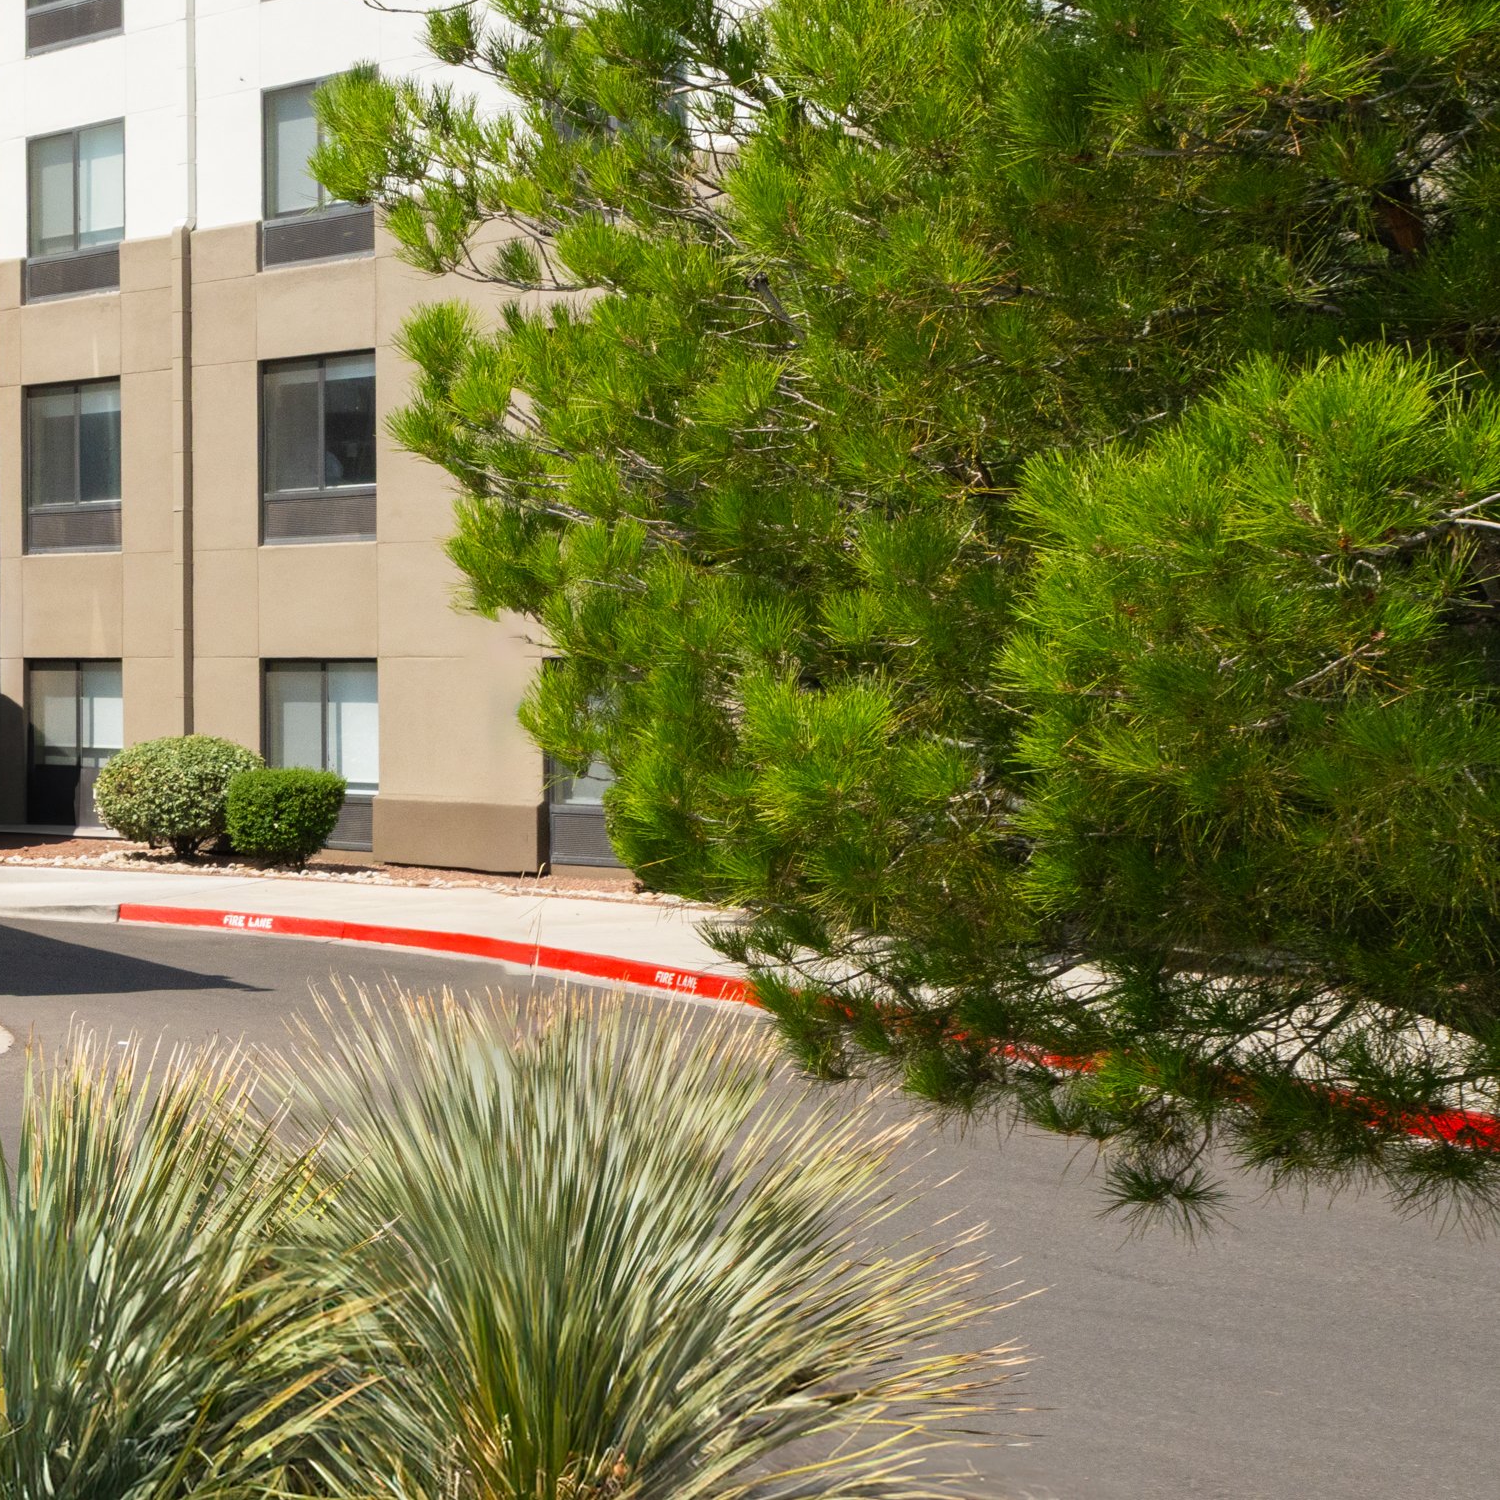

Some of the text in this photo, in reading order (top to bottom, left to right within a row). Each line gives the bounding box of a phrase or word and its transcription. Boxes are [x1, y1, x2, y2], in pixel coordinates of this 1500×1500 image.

[223, 914, 273, 929] FIRE LANE
[654, 970, 697, 990] FIRE LANE
